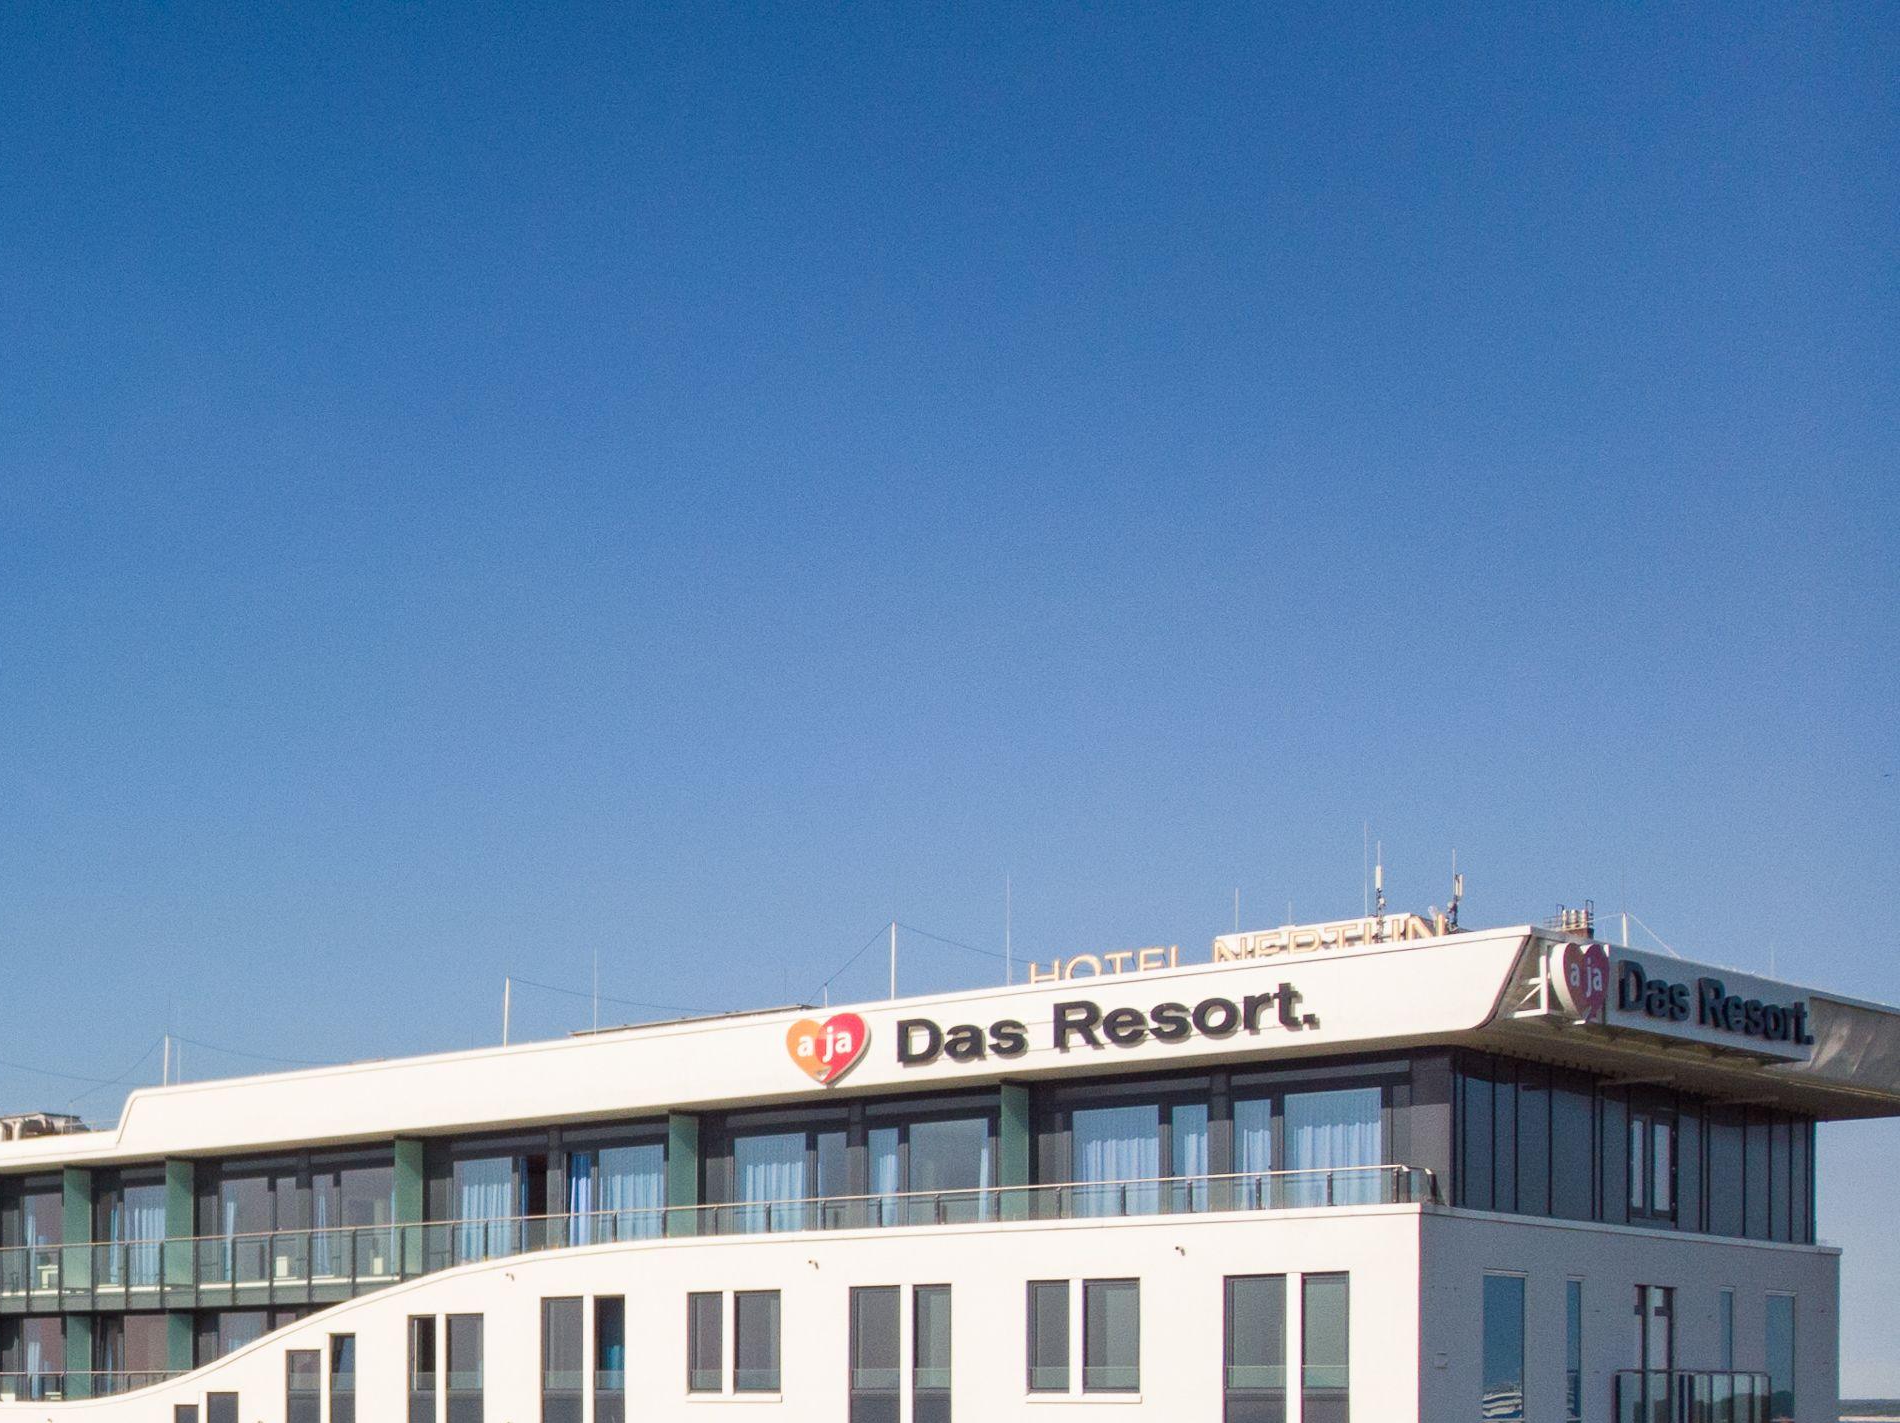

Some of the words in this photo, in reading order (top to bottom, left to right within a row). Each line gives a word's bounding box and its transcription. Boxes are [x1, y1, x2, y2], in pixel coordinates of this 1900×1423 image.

[897, 1017, 1027, 1066] Das
[1053, 982, 1320, 1052] Resort.
[1618, 959, 1690, 1021] Das
[1698, 977, 1814, 1046] Resort.
